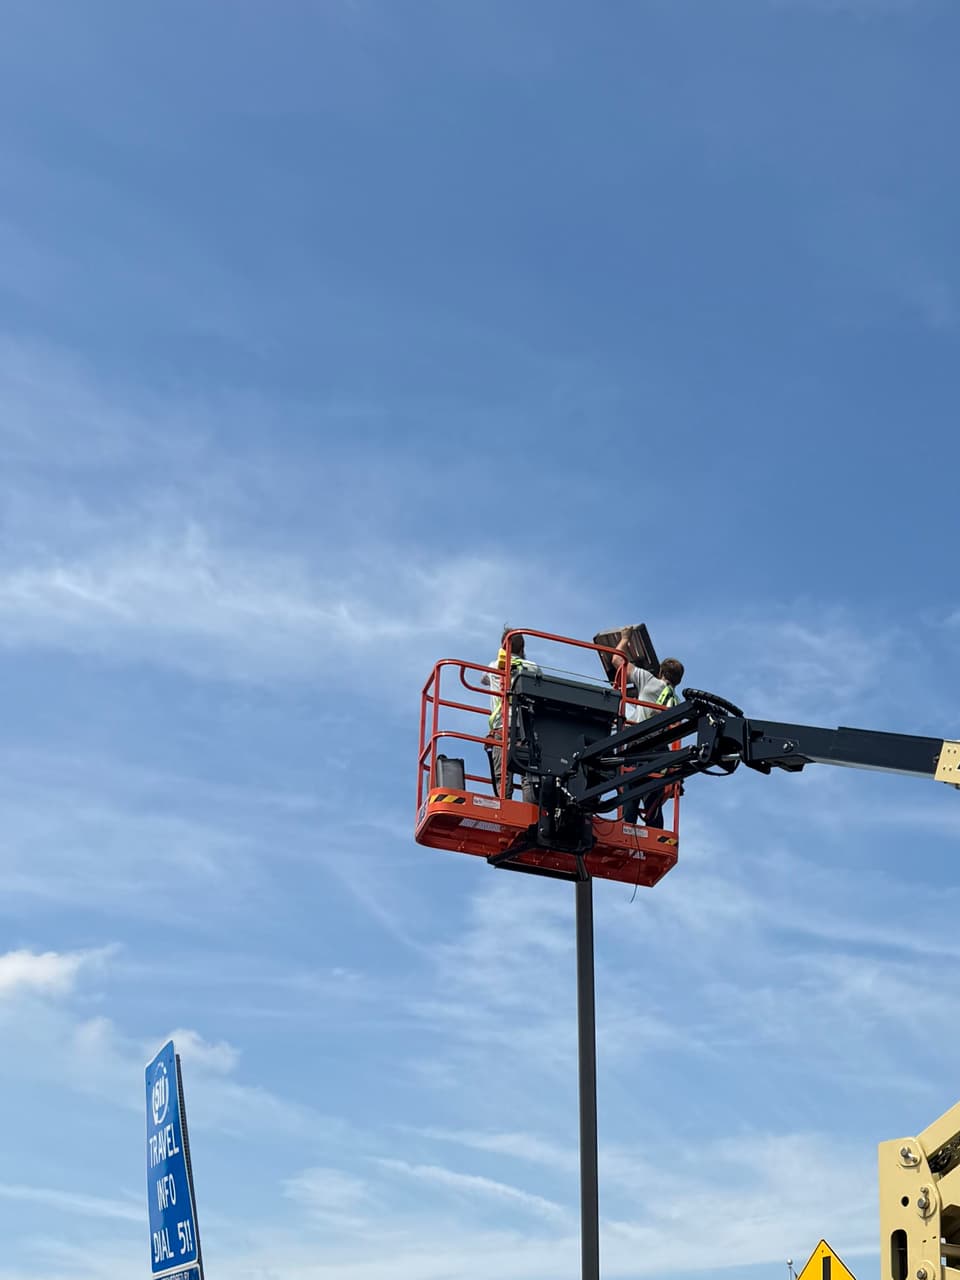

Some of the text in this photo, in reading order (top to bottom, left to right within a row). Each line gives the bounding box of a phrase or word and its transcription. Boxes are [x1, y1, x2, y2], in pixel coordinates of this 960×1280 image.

[149, 1122, 179, 1169] TRAVEL
[156, 1173, 176, 1213] INFO
[153, 1219, 193, 1263] DIAL 511
